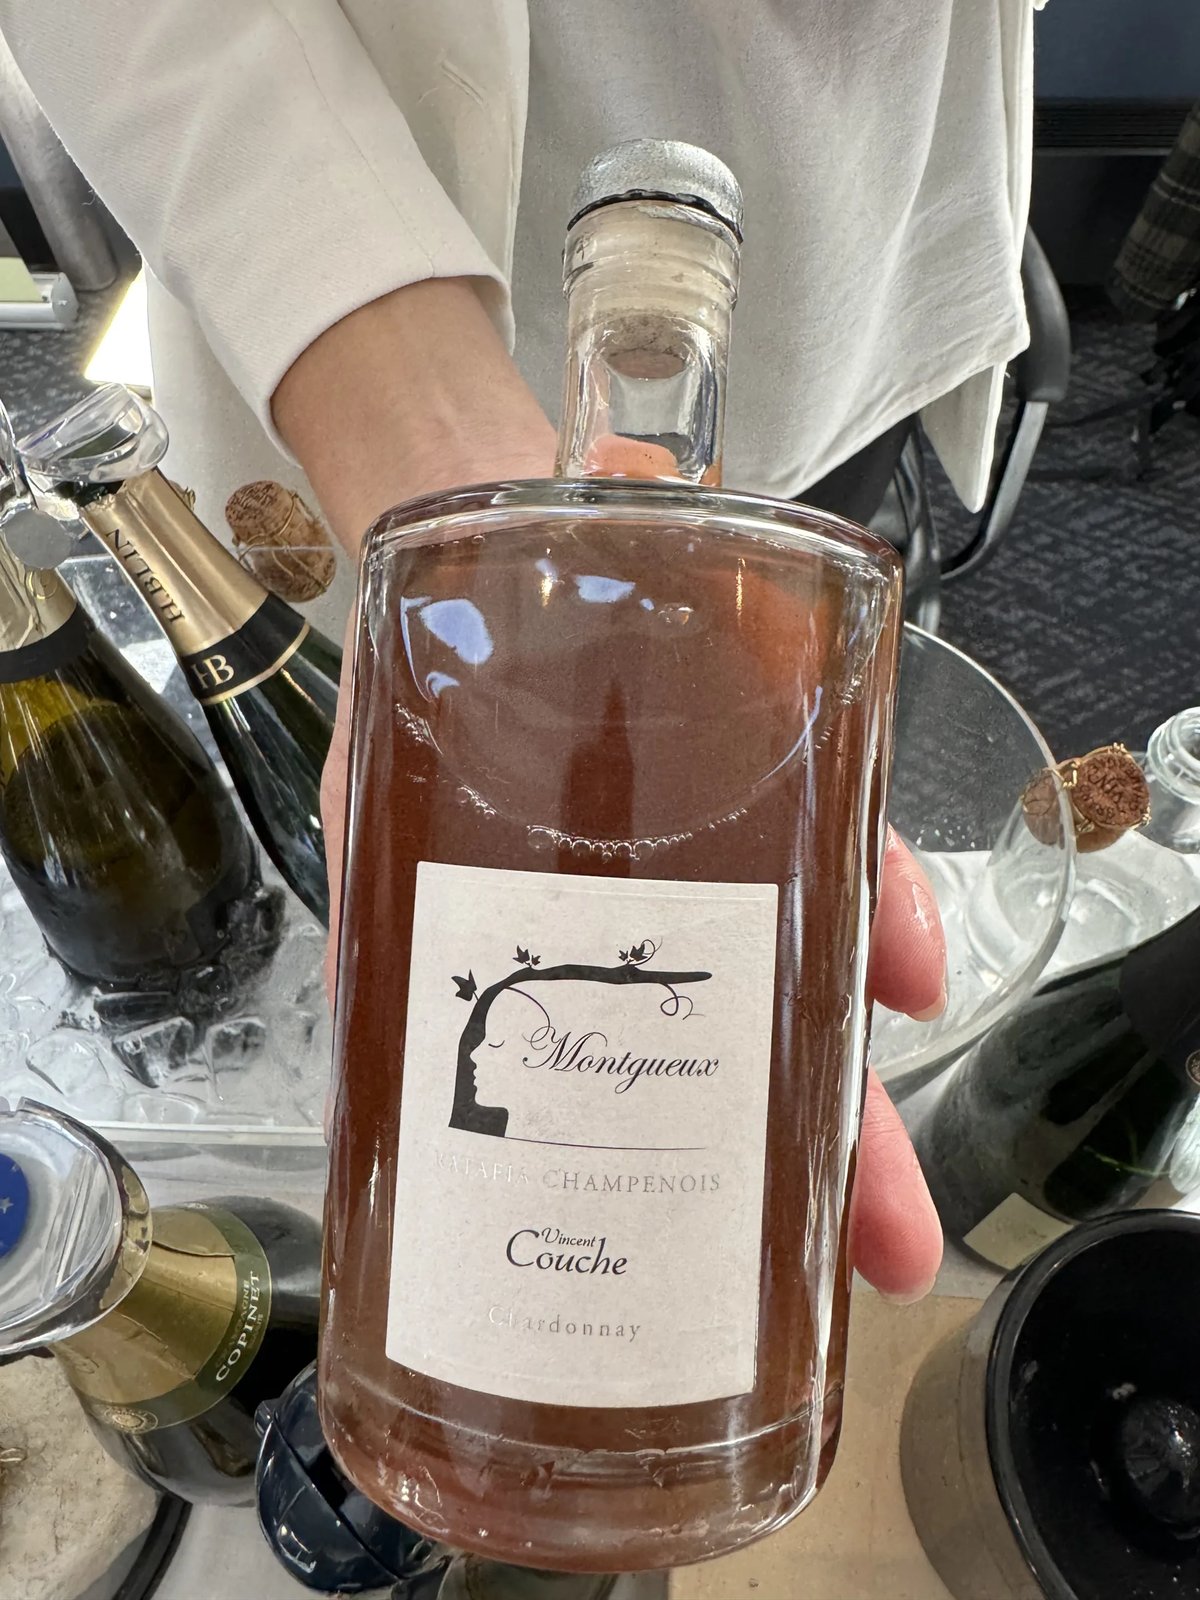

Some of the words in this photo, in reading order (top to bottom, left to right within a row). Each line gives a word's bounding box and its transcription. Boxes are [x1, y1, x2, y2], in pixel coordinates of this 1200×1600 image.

[191, 654, 235, 689] HB
[522, 1026, 719, 1094] Montgueux
[435, 1150, 529, 1185] RATAFIA
[542, 1168, 720, 1193] CHAMPENOIS
[506, 1229, 628, 1275] Couche
[541, 1227, 597, 1248] Vincent
[216, 1270, 260, 1381] COPINET
[488, 1305, 641, 1342] Chardonnay
